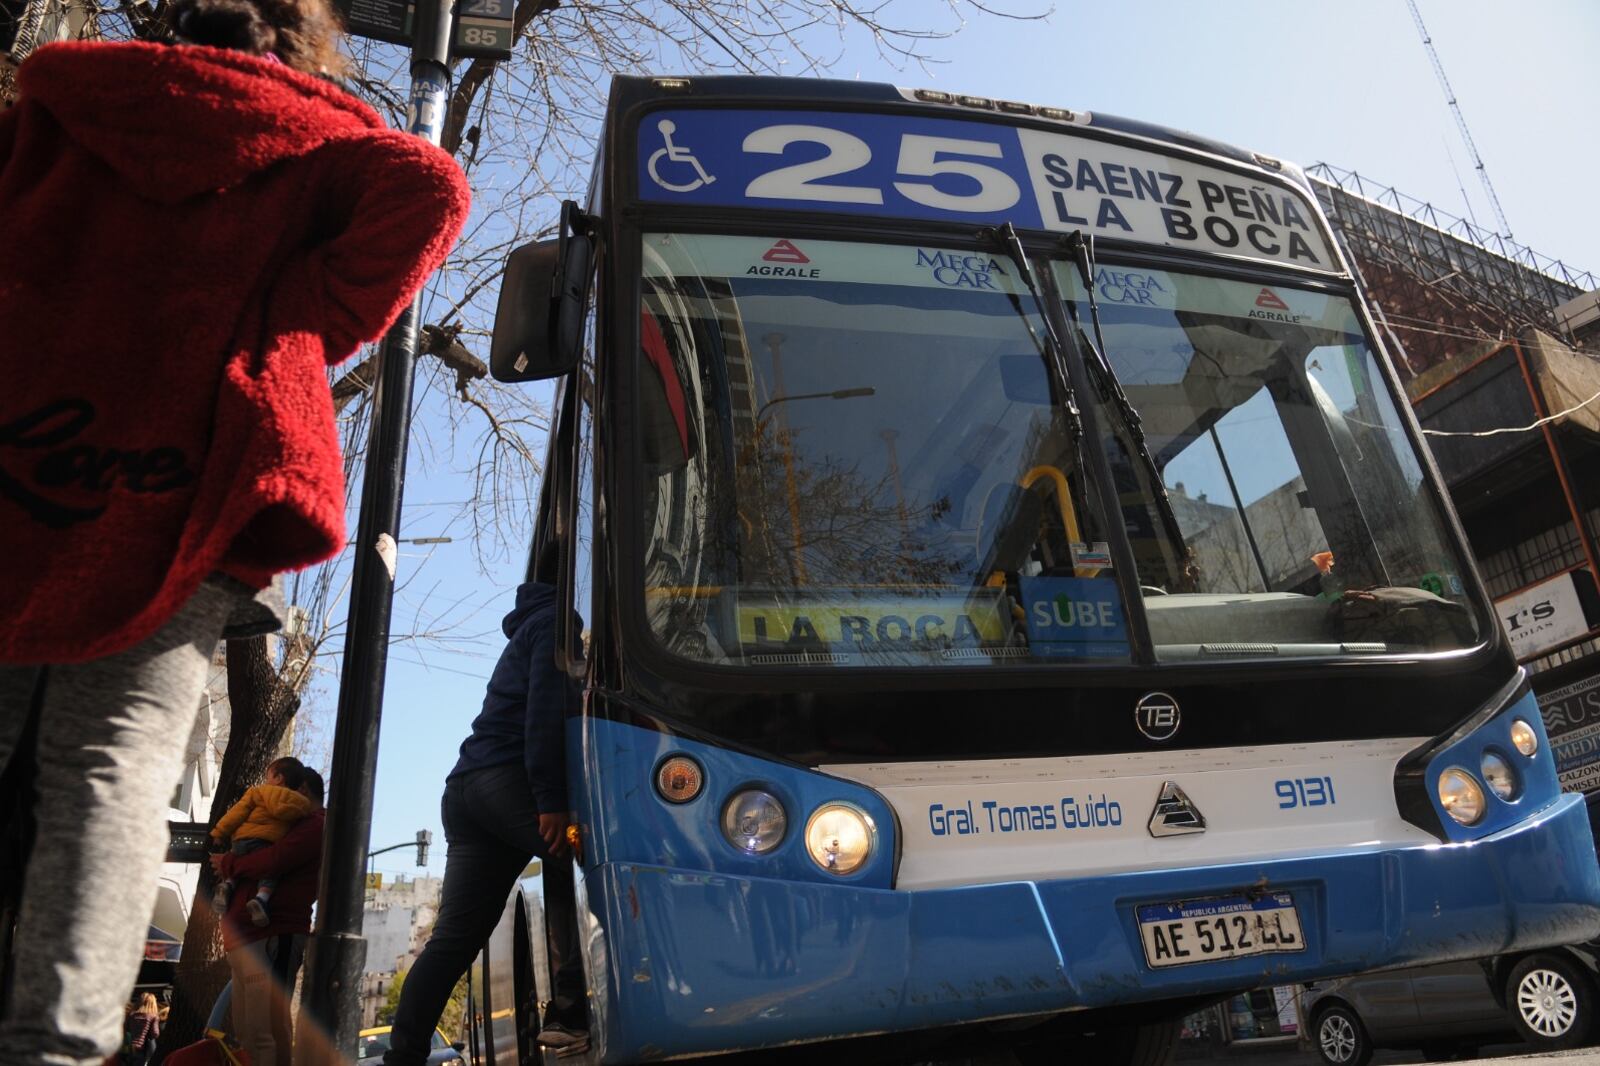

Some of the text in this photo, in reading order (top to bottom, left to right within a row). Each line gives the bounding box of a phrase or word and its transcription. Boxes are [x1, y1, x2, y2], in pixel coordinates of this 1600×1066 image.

[464, 28, 497, 46] 85
[742, 124, 1021, 213] 25
[1041, 154, 1310, 232] SAENZ PEÑA
[1052, 191, 1321, 265] LA BOCA
[746, 265, 821, 279] AGRALE
[915, 248, 1009, 276] MEGA
[933, 266, 996, 290] CAR
[1094, 268, 1168, 293] MEGA
[1100, 285, 1158, 306] CAR
[1248, 309, 1301, 324] AGRALE
[1033, 600, 1116, 627] SUBE
[754, 615, 822, 646] LA
[1559, 764, 1600, 783] CALZON
[1275, 776, 1336, 809] 9131
[929, 793, 1122, 836] Gral. Tomas Guido
[1217, 903, 1254, 915] ARGENTINA
[1153, 923, 1190, 960] AE
[1195, 915, 1252, 953] 512
